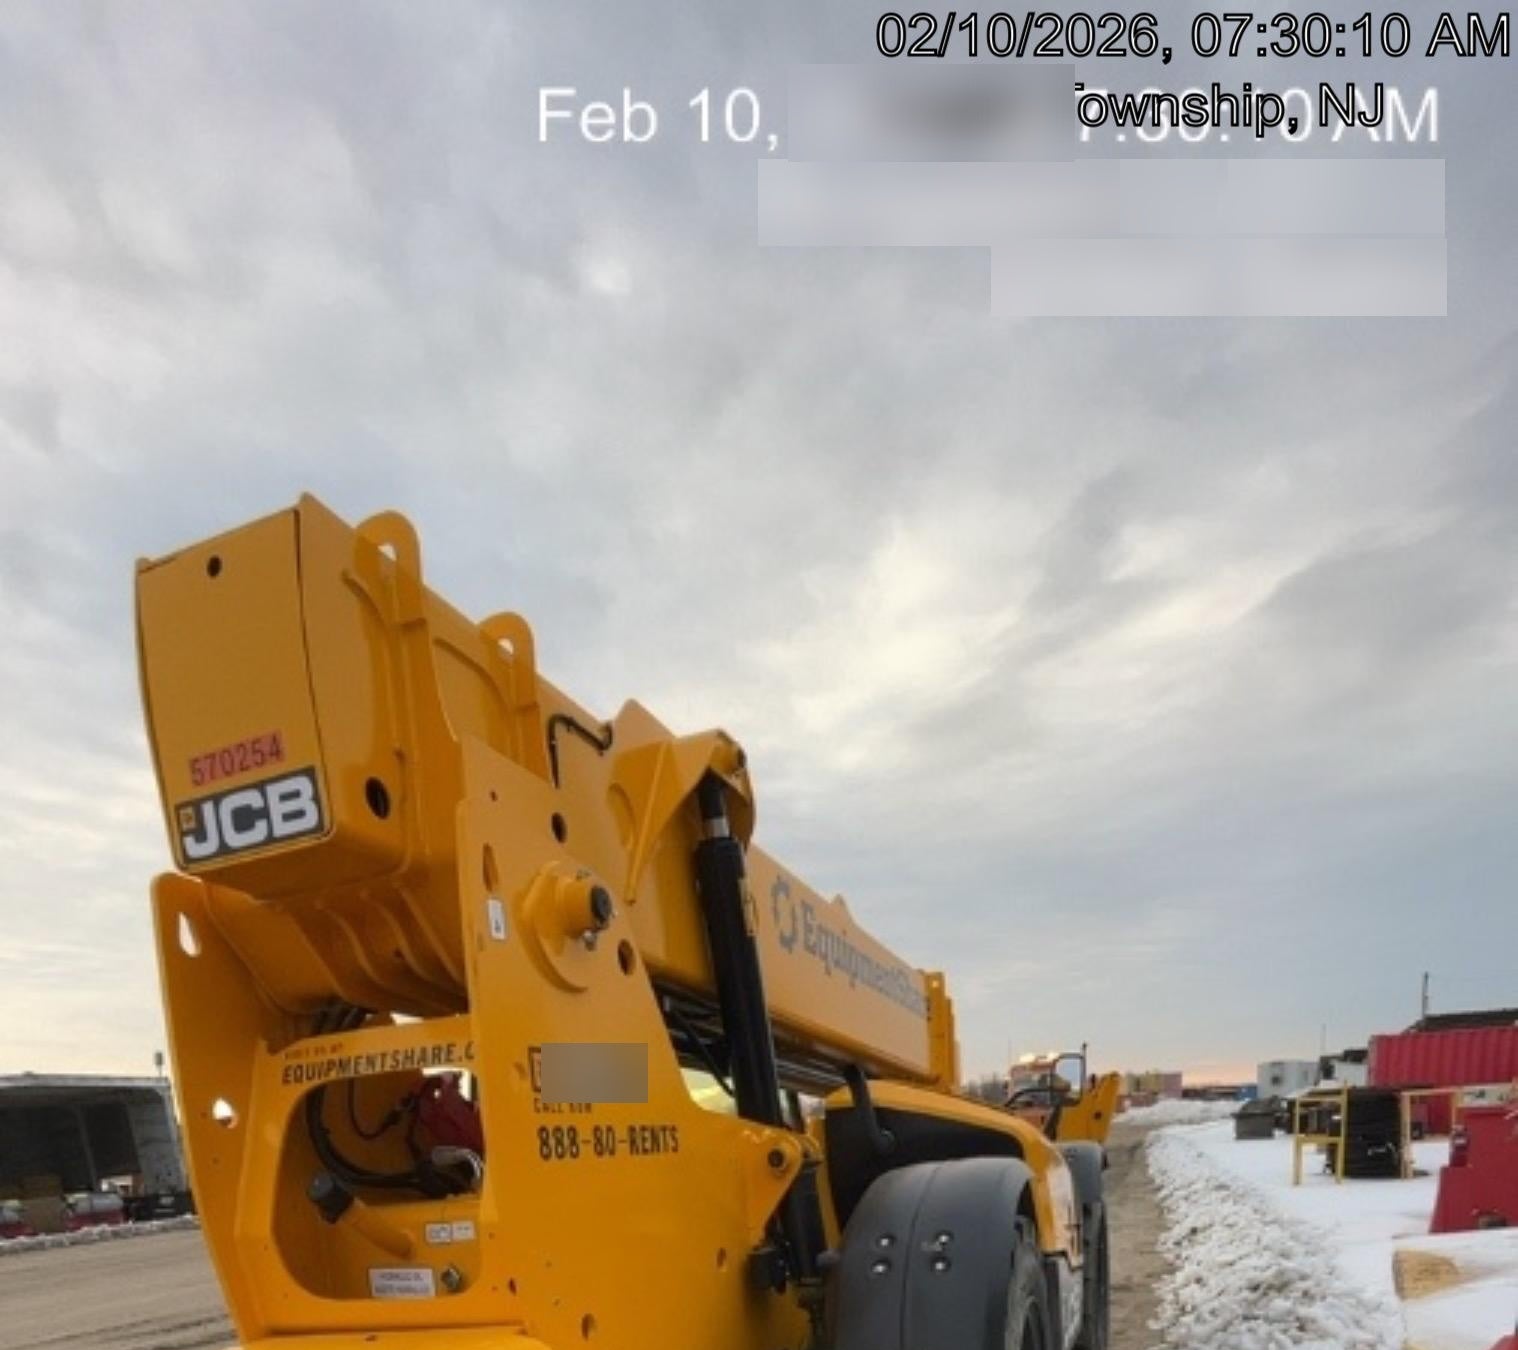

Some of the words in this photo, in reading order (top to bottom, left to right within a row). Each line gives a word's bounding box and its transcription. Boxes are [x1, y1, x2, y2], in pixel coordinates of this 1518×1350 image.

[190, 733, 284, 786] 570254
[182, 775, 321, 860] JCB
[537, 1123, 679, 1162] 888-80-RENTS
